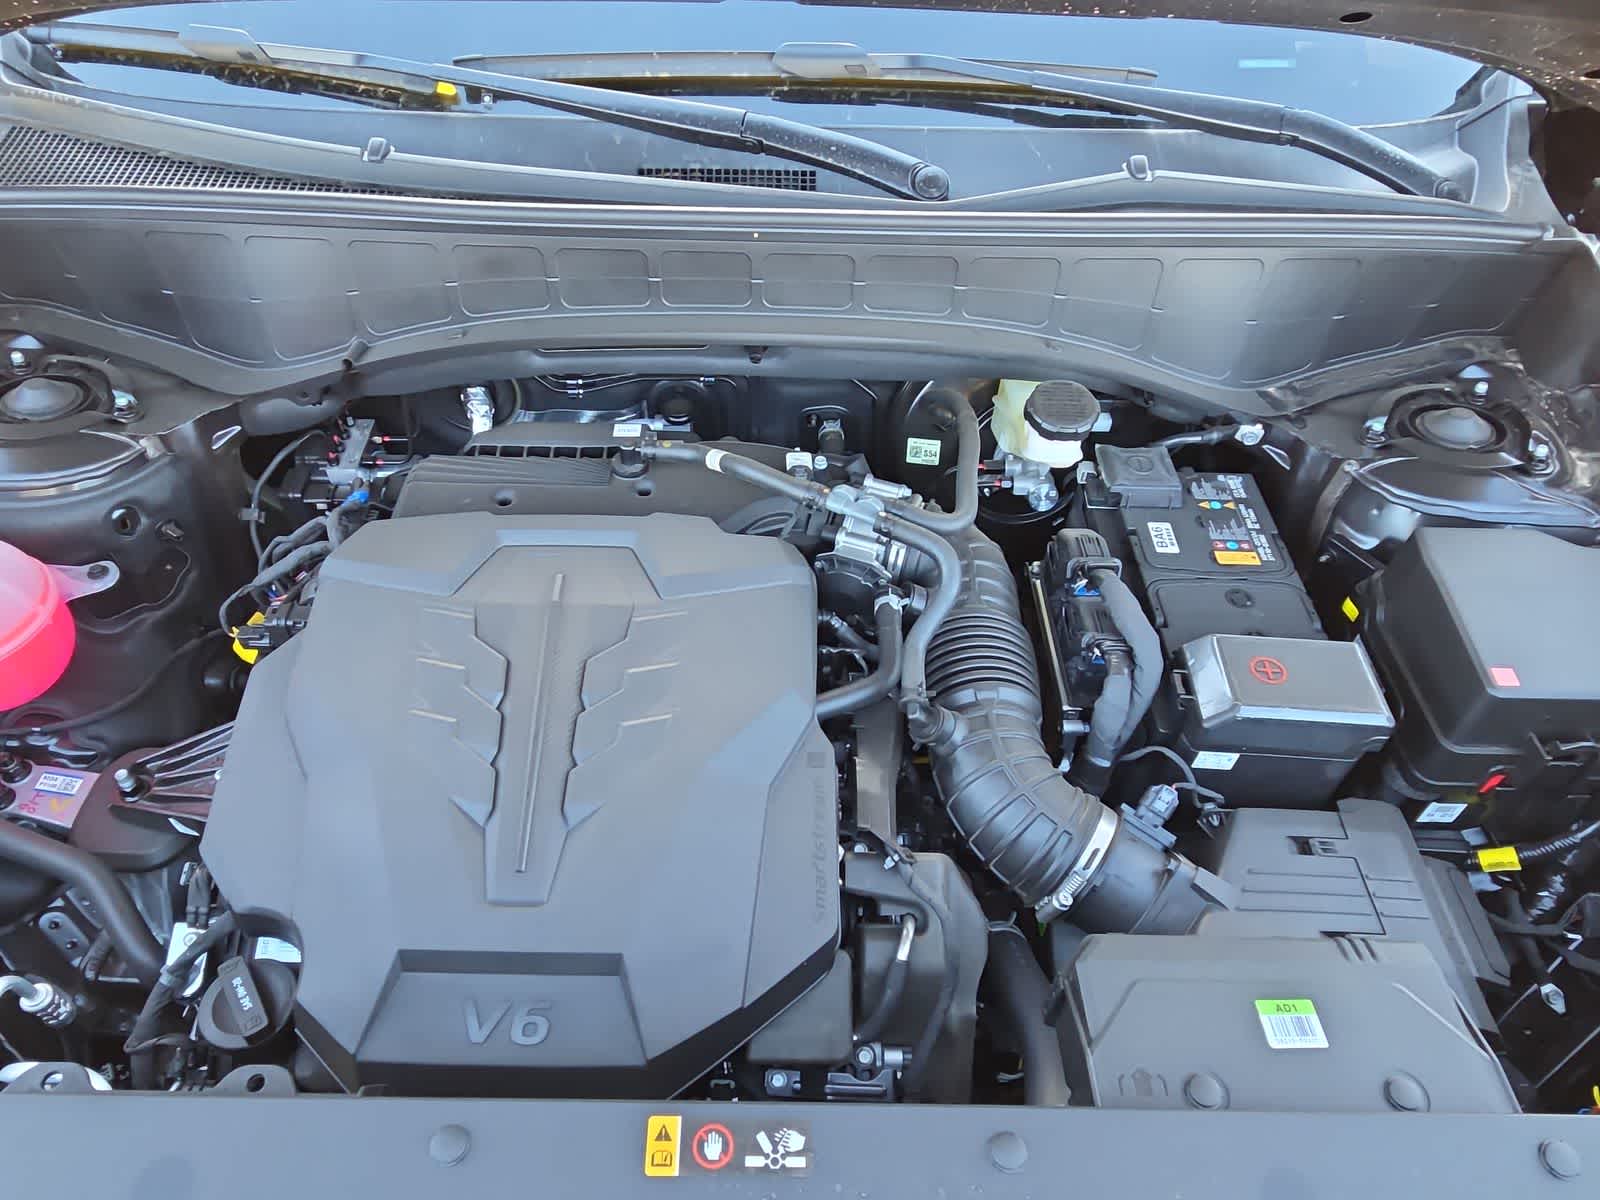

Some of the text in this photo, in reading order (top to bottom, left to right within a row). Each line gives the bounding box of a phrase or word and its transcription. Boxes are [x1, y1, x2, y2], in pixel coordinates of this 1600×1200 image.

[239, 995, 254, 1011] SAE
[1275, 1003, 1298, 1013] AD1
[463, 998, 552, 1046] V6
